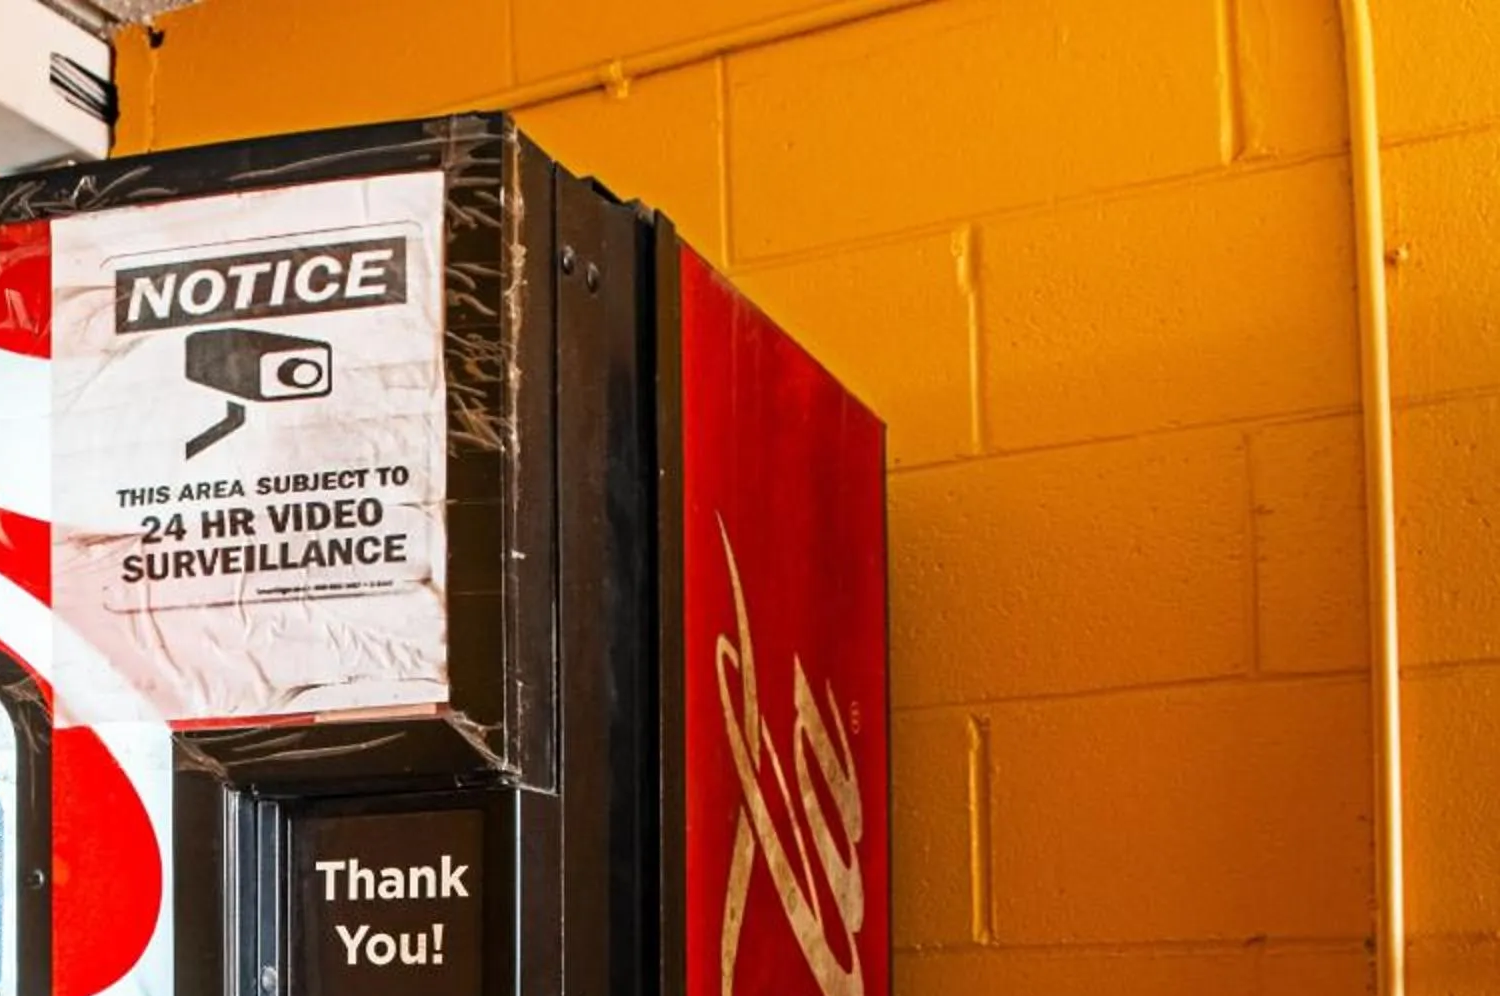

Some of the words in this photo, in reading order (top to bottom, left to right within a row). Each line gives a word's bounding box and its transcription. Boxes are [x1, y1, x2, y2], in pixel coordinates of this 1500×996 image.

[126, 248, 394, 323] NOTICE
[116, 487, 171, 507] THIS
[178, 480, 245, 502] AREA
[256, 469, 369, 495] SUBJECT
[376, 465, 409, 487] TO
[141, 513, 187, 545] 24
[201, 508, 256, 539] HR
[267, 498, 384, 533] VIDEO
[121, 533, 408, 583] SURVEILLANCE
[315, 855, 469, 901] Thank
[335, 923, 444, 965] You!
